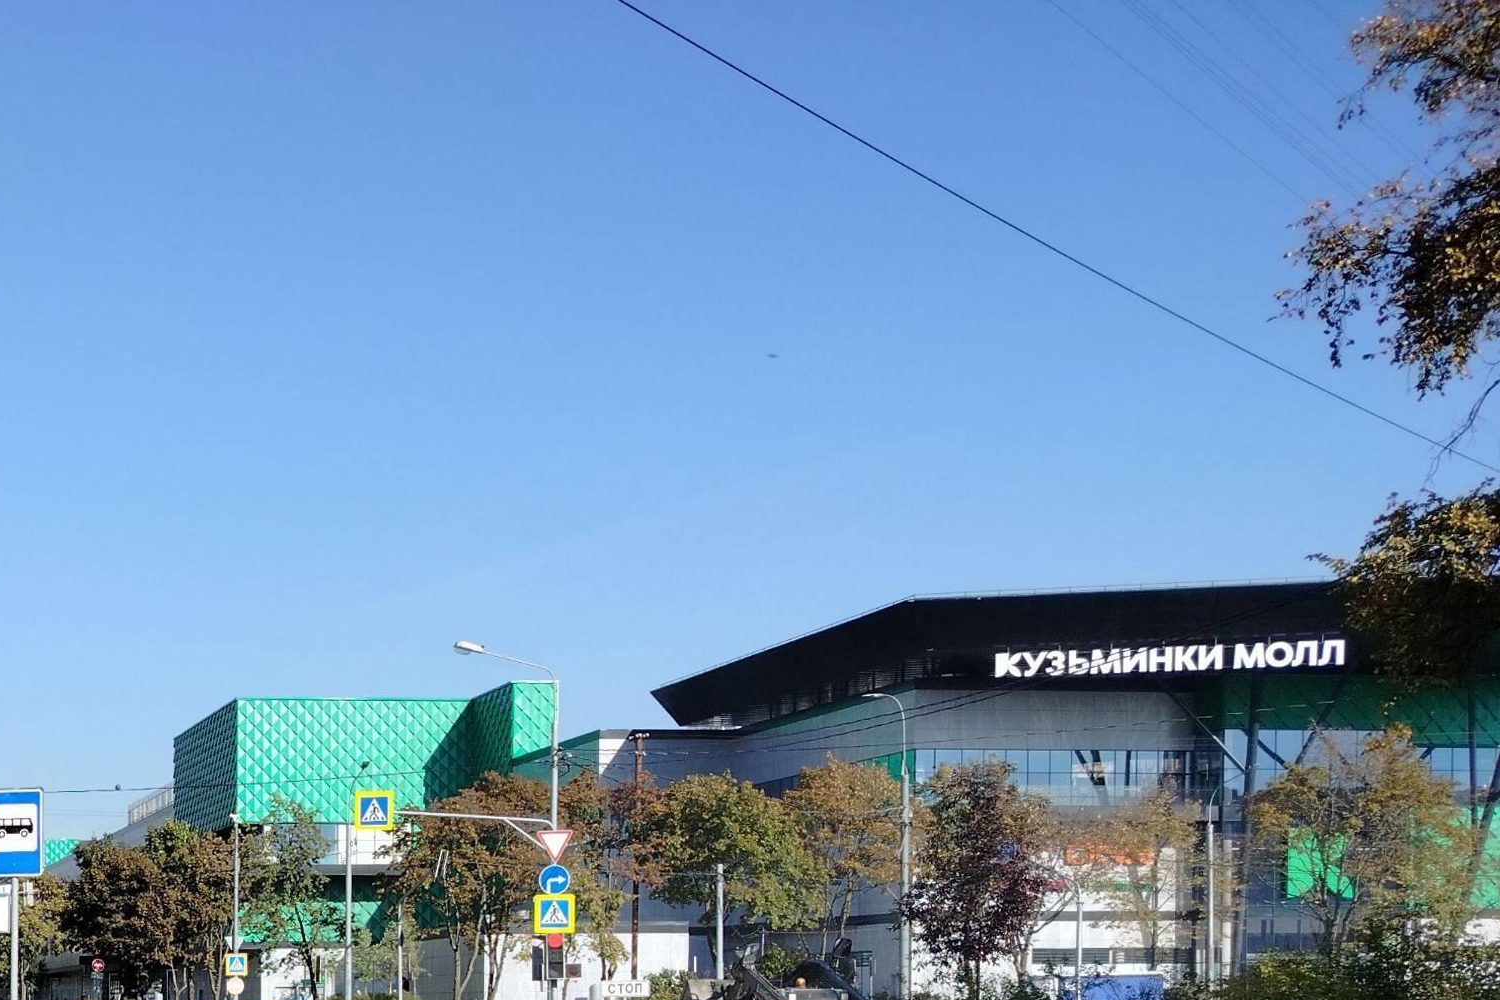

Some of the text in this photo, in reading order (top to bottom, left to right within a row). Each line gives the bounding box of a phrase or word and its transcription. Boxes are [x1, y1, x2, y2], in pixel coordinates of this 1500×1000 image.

[994, 639, 1346, 678] КУЗЬМИНКИ МОЛЛ
[608, 983, 642, 994] СТОП
